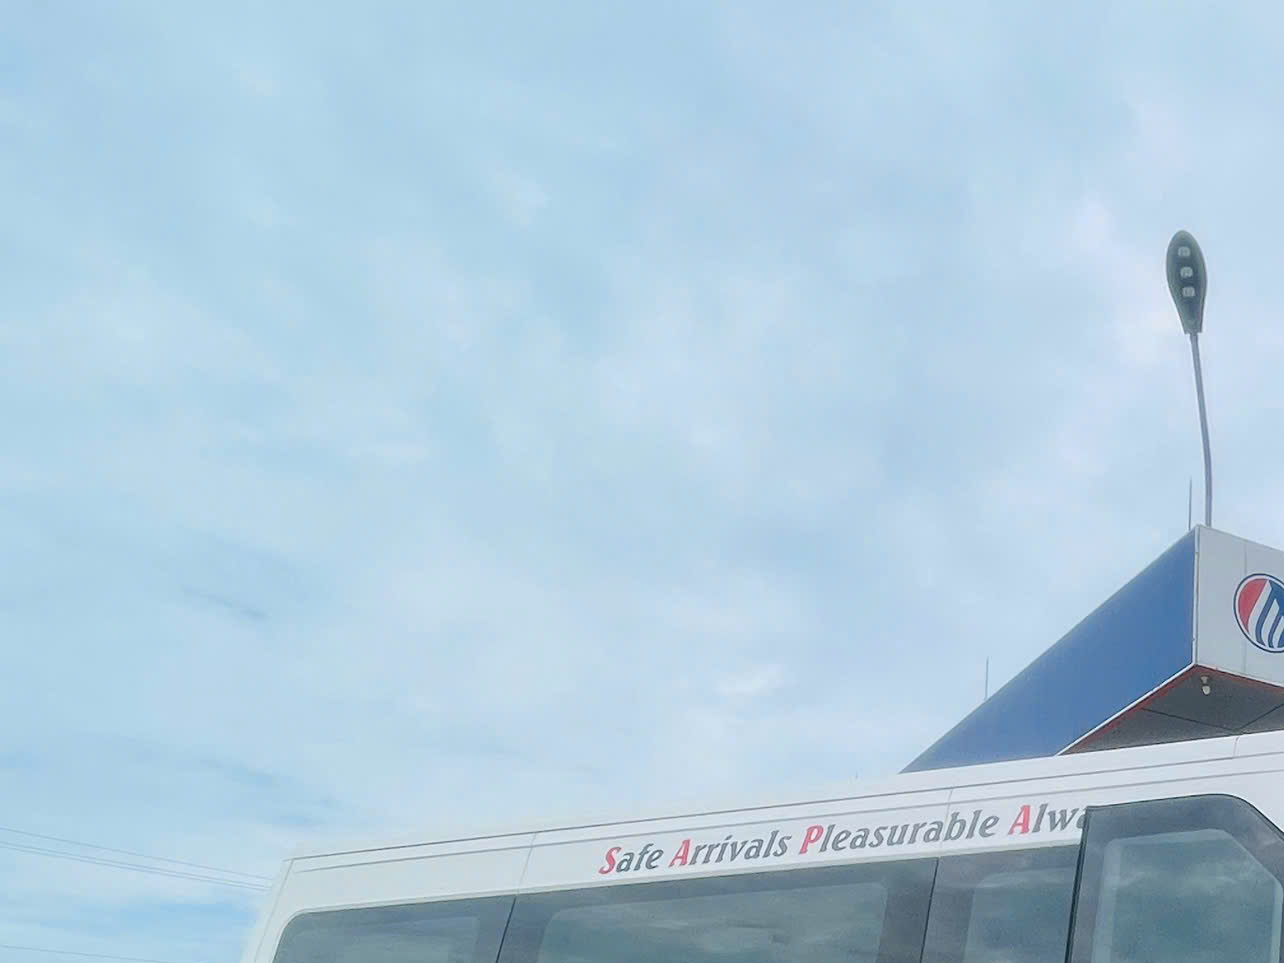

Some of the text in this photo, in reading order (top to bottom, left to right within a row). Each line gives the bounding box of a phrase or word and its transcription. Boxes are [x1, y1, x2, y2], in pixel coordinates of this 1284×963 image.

[598, 844, 663, 875] Safe
[668, 829, 793, 868] Arrivals
[799, 811, 1000, 855] Pleasurable
